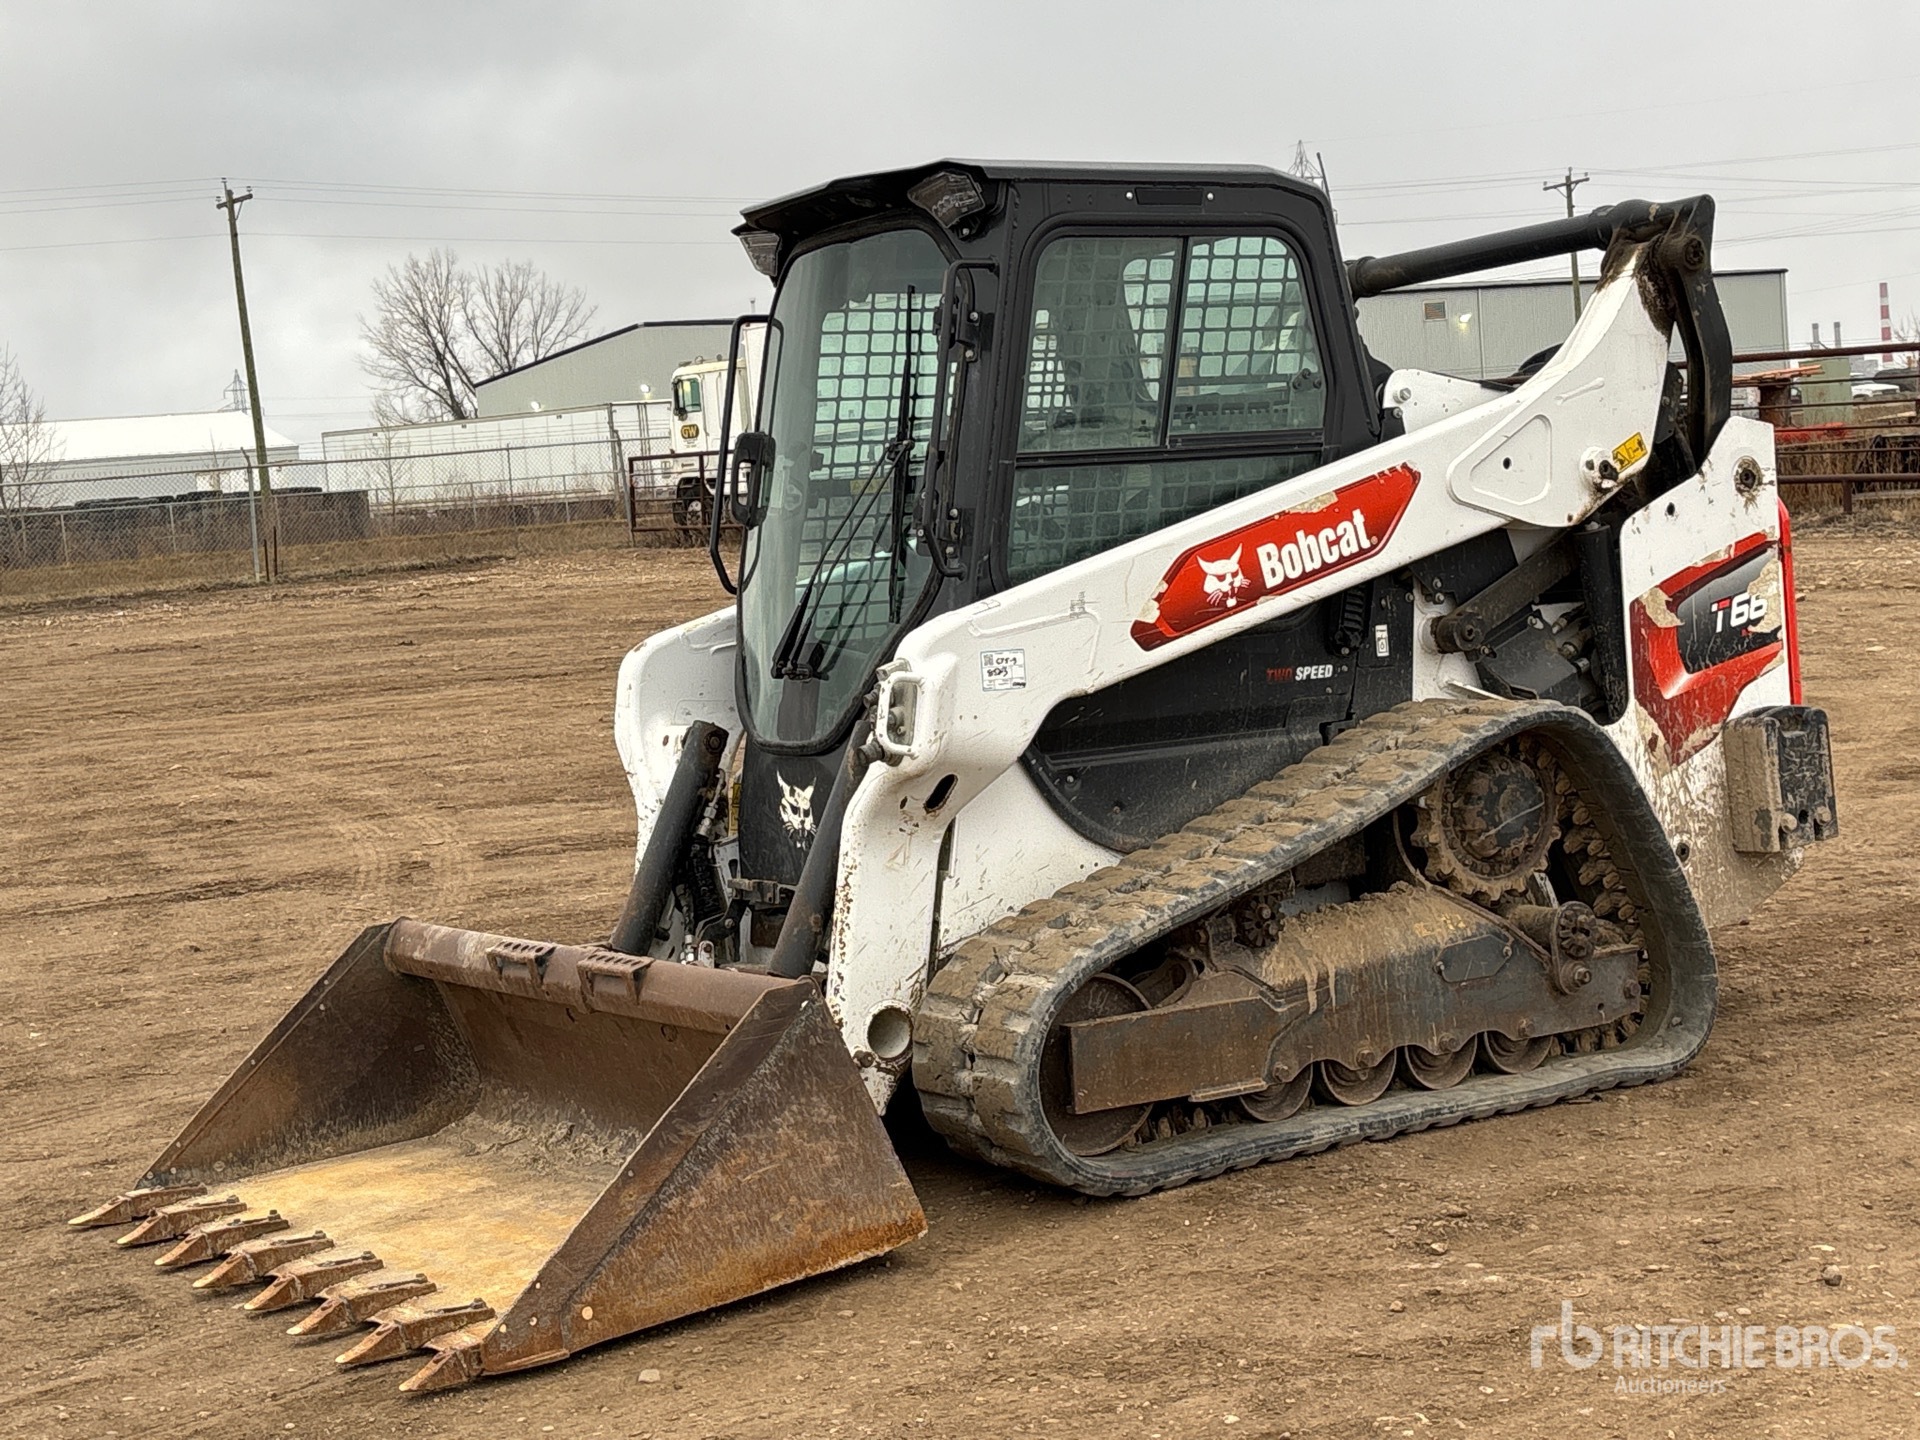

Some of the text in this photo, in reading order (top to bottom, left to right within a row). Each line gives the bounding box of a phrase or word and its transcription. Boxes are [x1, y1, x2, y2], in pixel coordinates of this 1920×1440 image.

[682, 425, 697, 438] GW
[1257, 509, 1371, 589] Bobcat
[1711, 592, 1768, 633] T66
[1267, 664, 1333, 682] TWO SPEED
